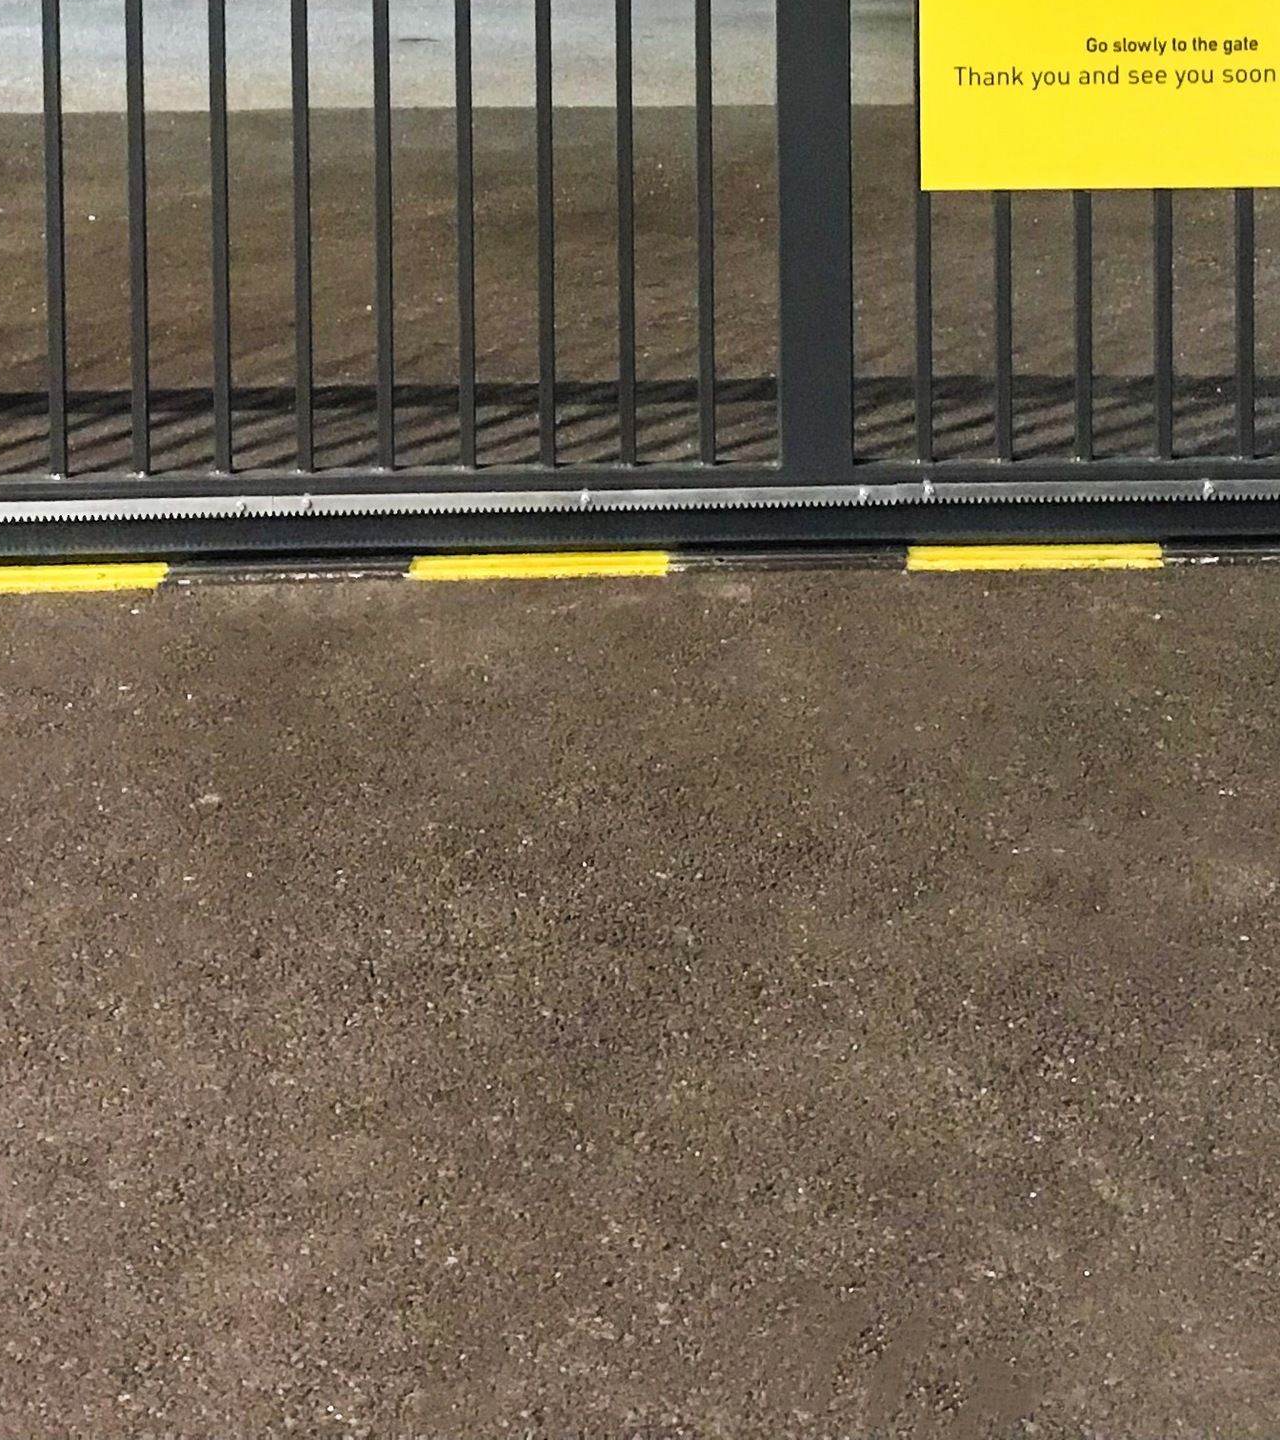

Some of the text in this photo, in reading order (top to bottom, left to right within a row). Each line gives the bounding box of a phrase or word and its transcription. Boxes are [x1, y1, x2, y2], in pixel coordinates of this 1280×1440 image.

[1085, 36, 1259, 57] Go slowly to the gate
[953, 65, 1024, 87] Thank
[1031, 69, 1071, 91] you
[1078, 64, 1120, 86] and
[1127, 69, 1168, 85] see
[1174, 68, 1214, 90] you
[1222, 67, 1277, 84] soon
